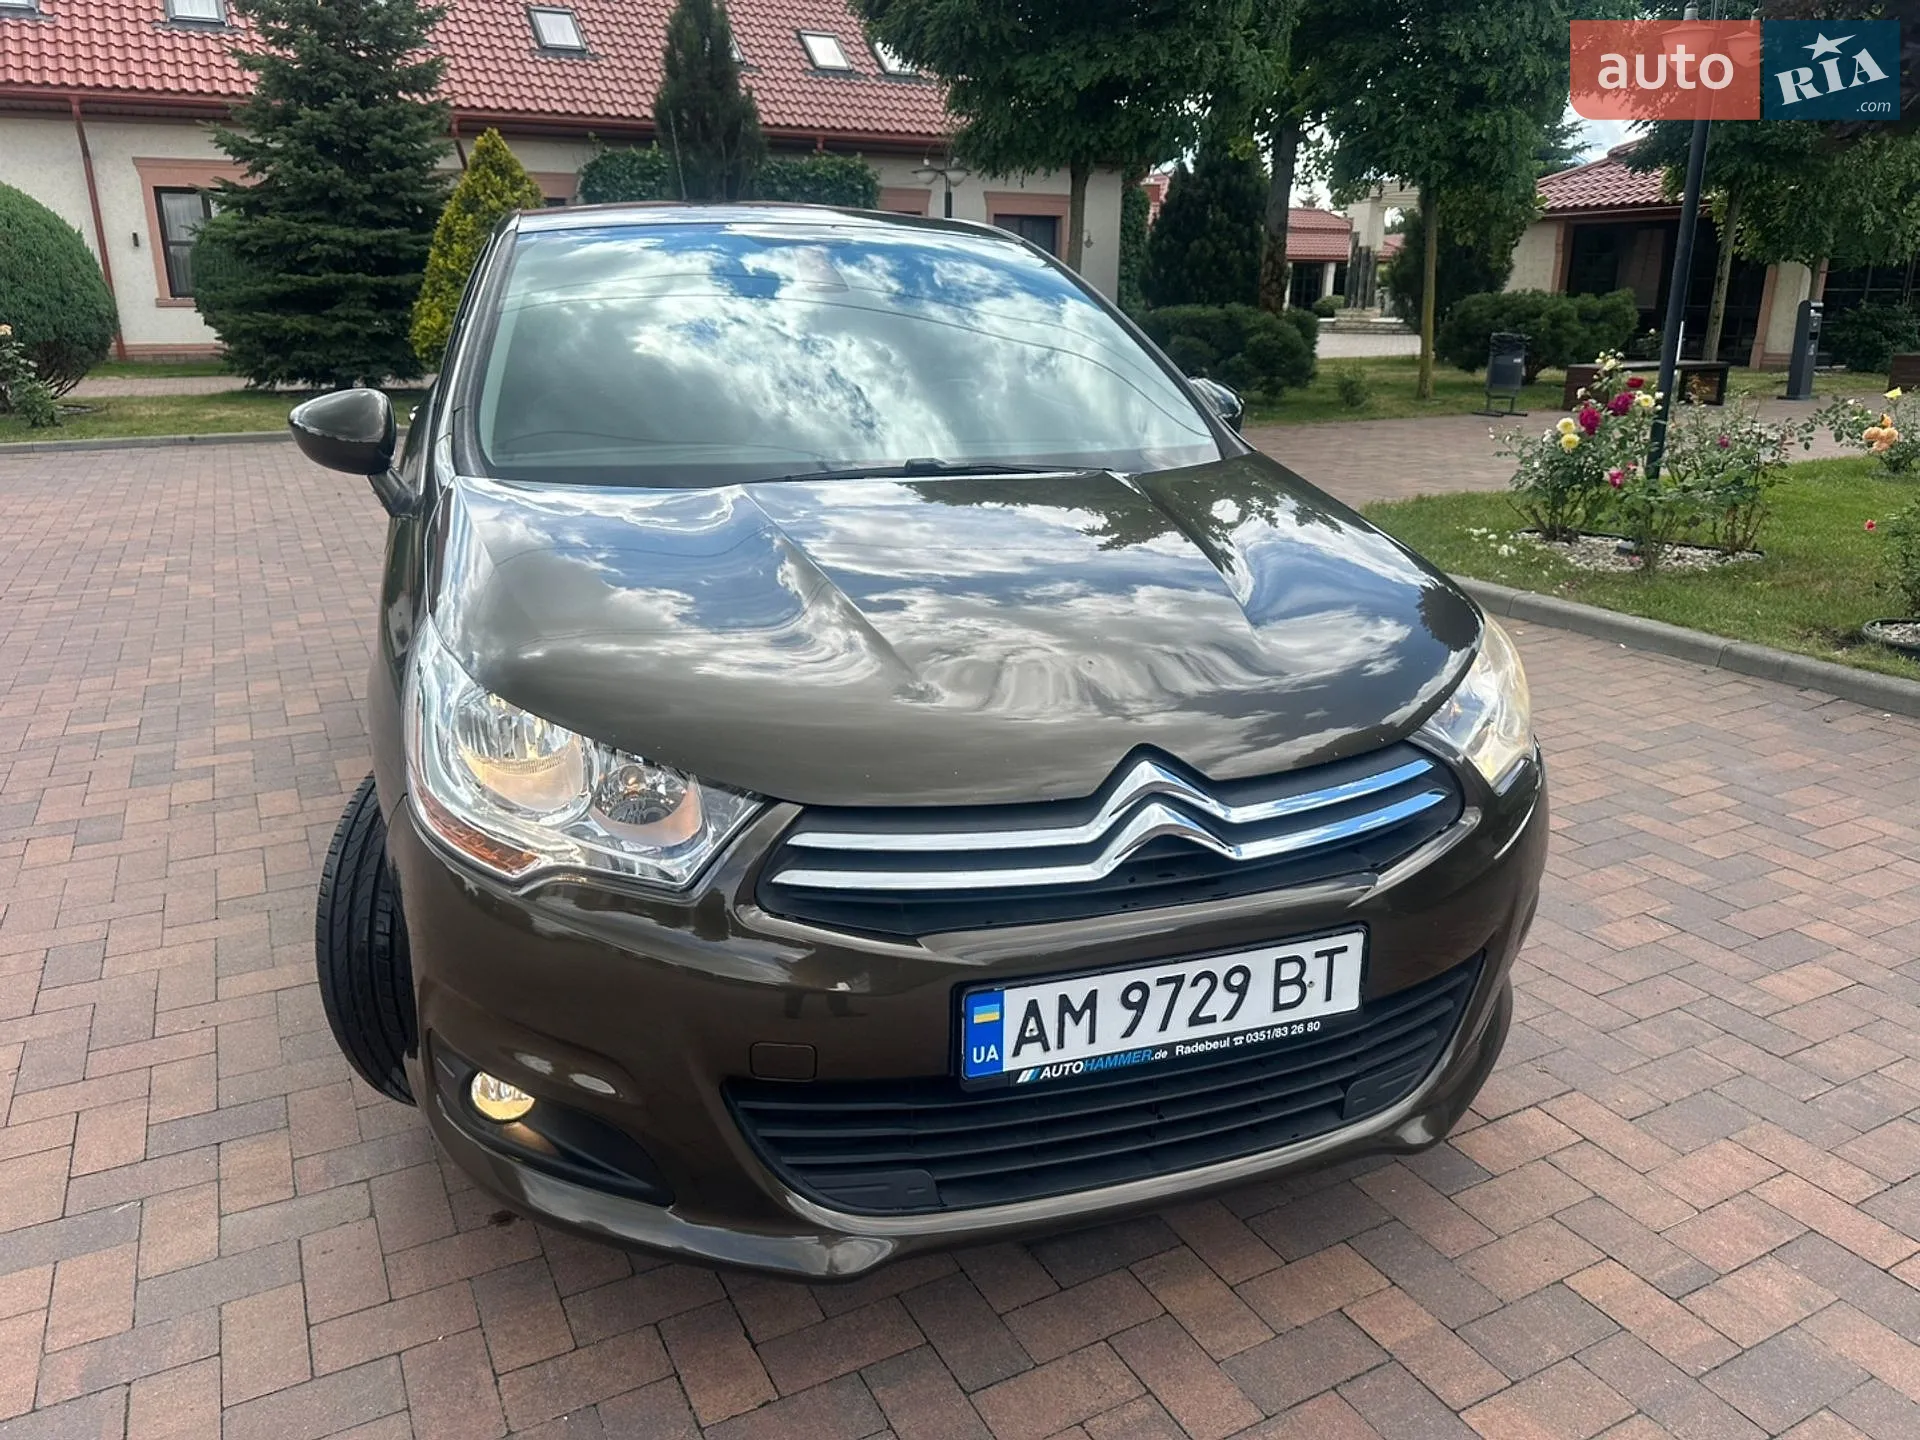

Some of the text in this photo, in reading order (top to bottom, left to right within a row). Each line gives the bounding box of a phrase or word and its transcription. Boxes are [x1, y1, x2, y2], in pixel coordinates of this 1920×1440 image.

[1011, 945, 1348, 1058] AM 9729 BT
[973, 1047, 999, 1064] UA
[1175, 1038, 1231, 1057] Radebeul
[1245, 1025, 1289, 1044] 0351/83
[1290, 1022, 1305, 1036] 26
[1306, 1020, 1321, 1032] 80
